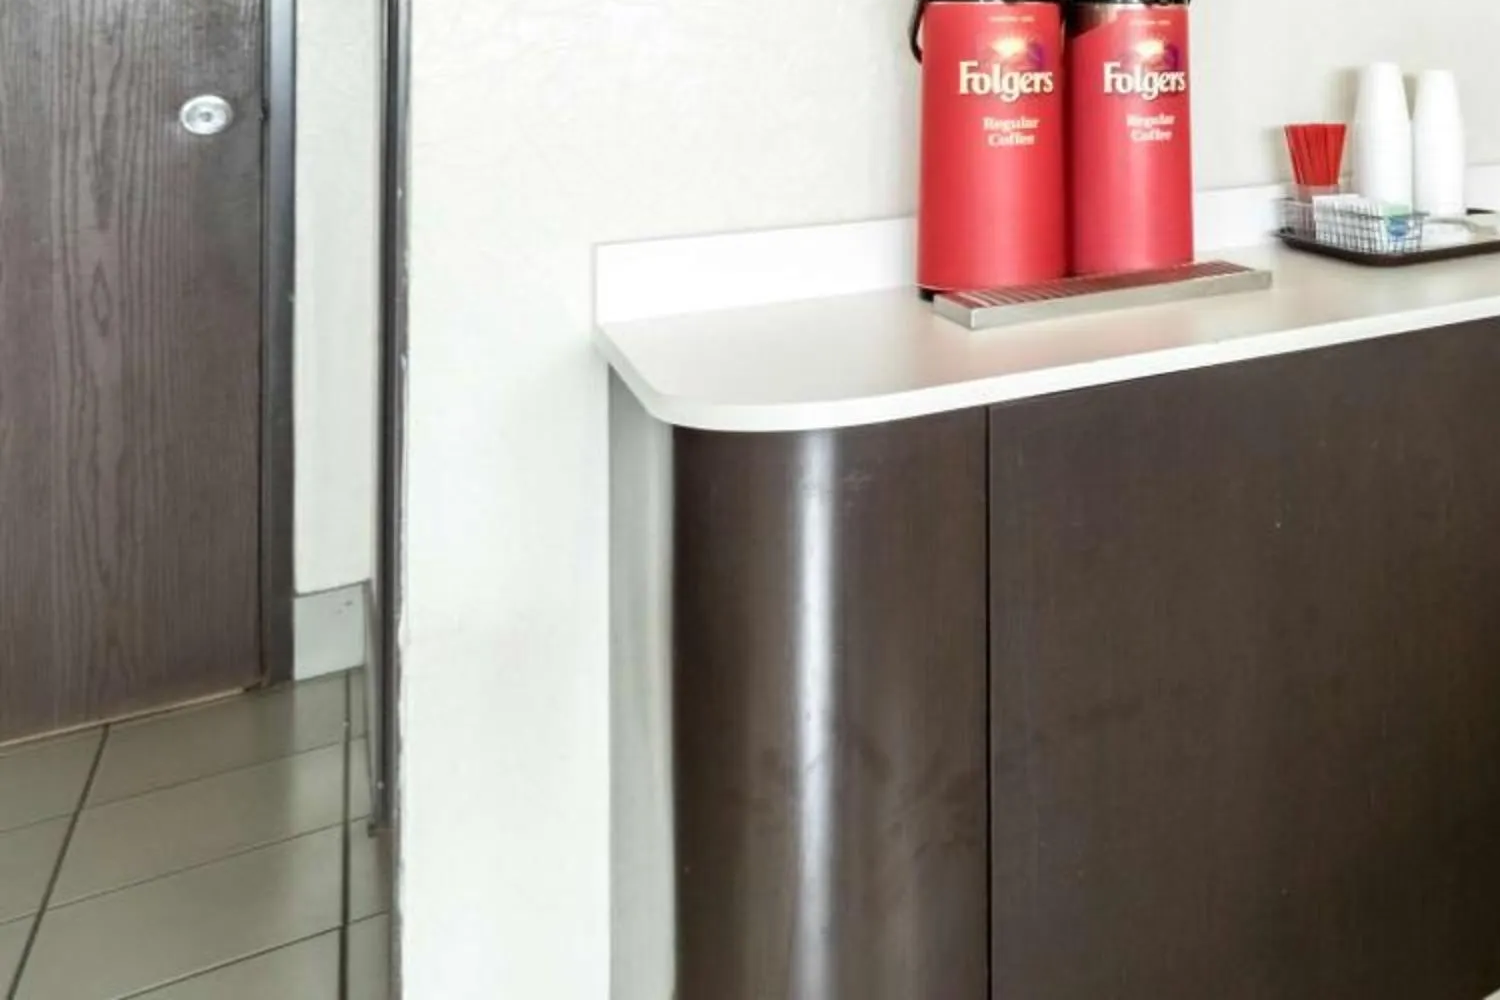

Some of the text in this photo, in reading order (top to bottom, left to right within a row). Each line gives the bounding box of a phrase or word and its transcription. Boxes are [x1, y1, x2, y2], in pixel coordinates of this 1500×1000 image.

[959, 61, 1054, 102] Folgers
[1103, 61, 1187, 100] Folgers
[983, 116, 1040, 132] Regular
[1126, 113, 1176, 129] Regular
[988, 132, 1035, 146] Coffee
